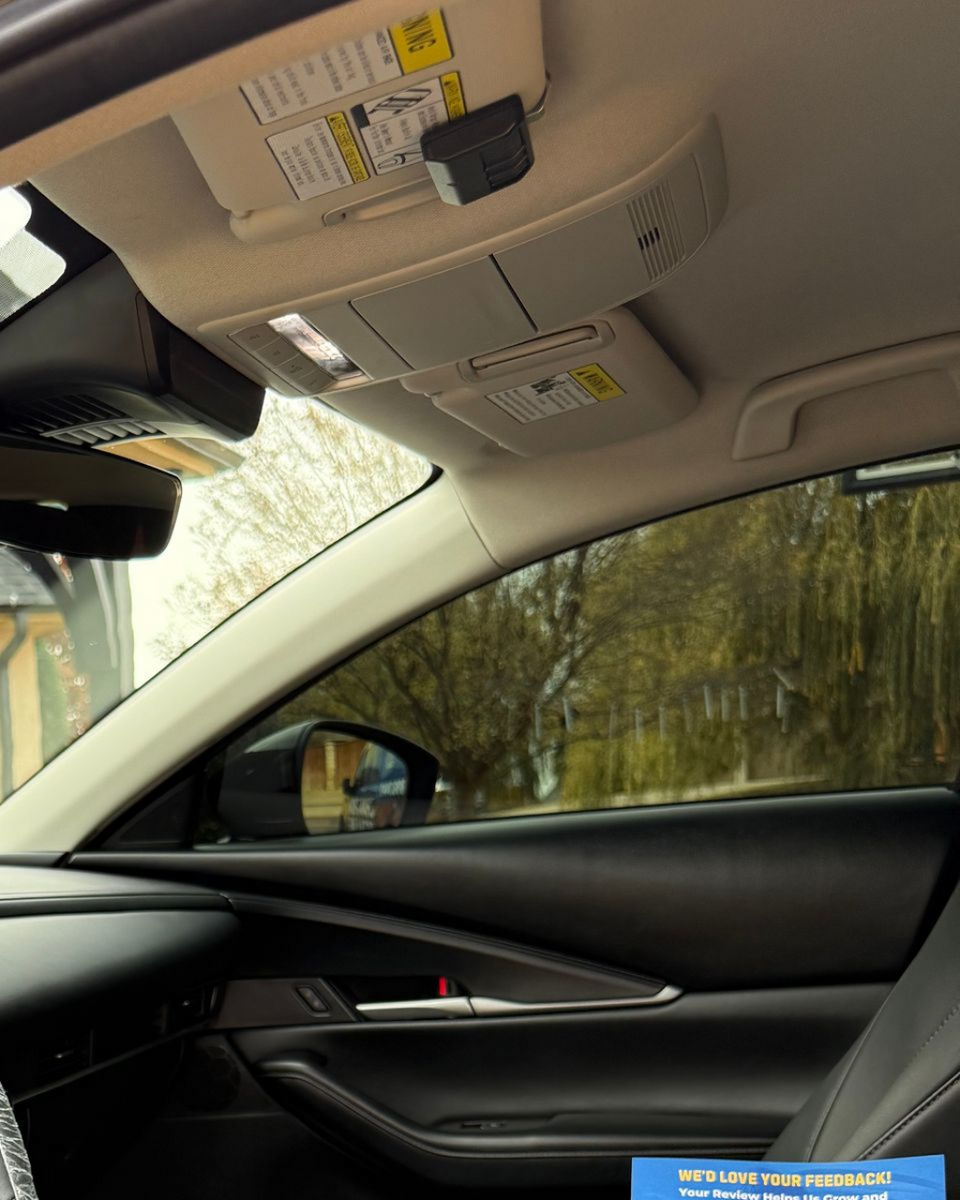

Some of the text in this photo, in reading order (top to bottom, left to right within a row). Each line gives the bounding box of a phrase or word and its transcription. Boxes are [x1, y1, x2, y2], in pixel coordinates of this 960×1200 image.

[401, 14, 436, 53] NING
[678, 1169, 892, 1188] WE'D LOVE YOUR FEEDBACK!
[678, 1188, 710, 1198] Your
[712, 1189, 760, 1200] Review
